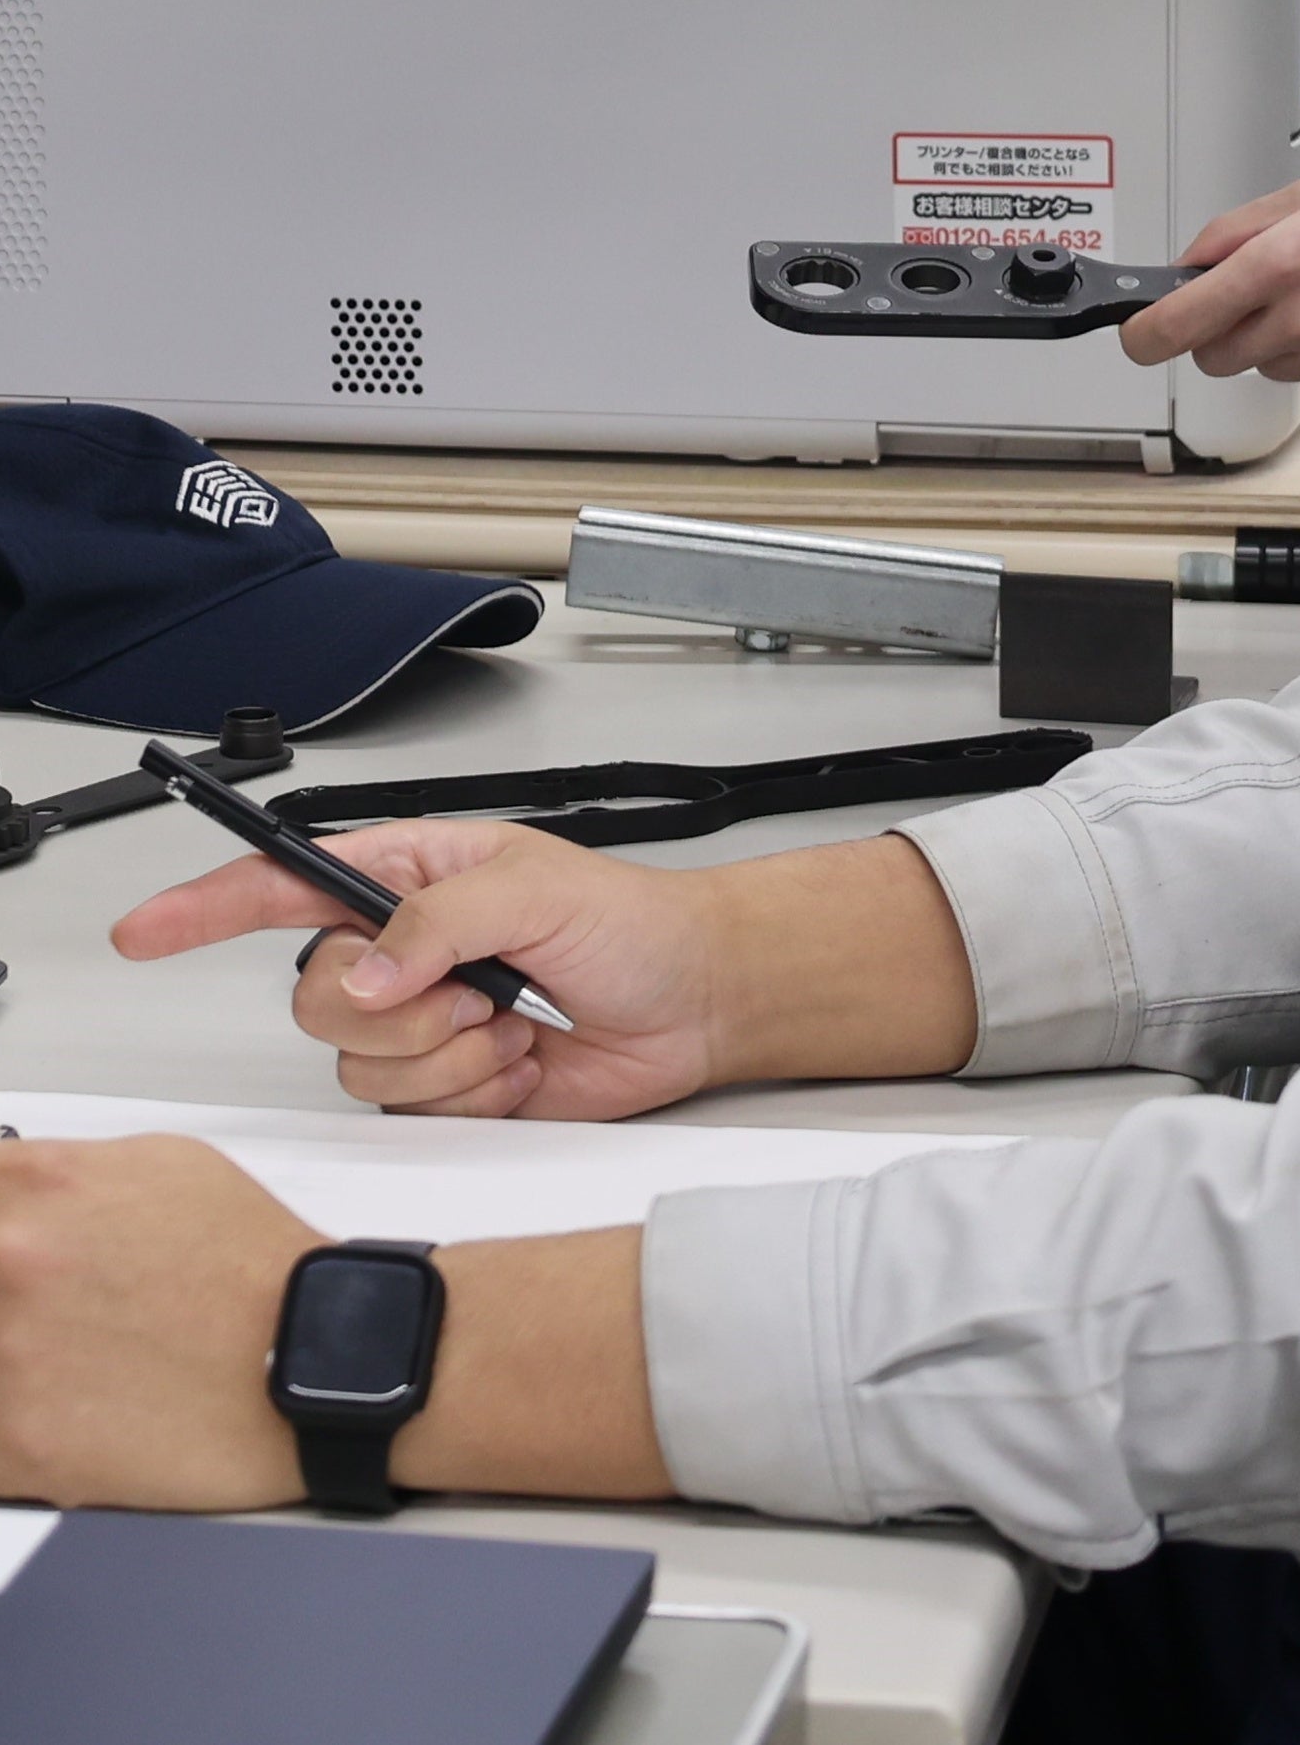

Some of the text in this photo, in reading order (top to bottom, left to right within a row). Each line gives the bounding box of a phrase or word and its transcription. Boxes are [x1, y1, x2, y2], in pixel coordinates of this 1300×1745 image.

[913, 192, 1093, 221] お客様相談センター
[935, 226, 1102, 251] 0120-654-632
